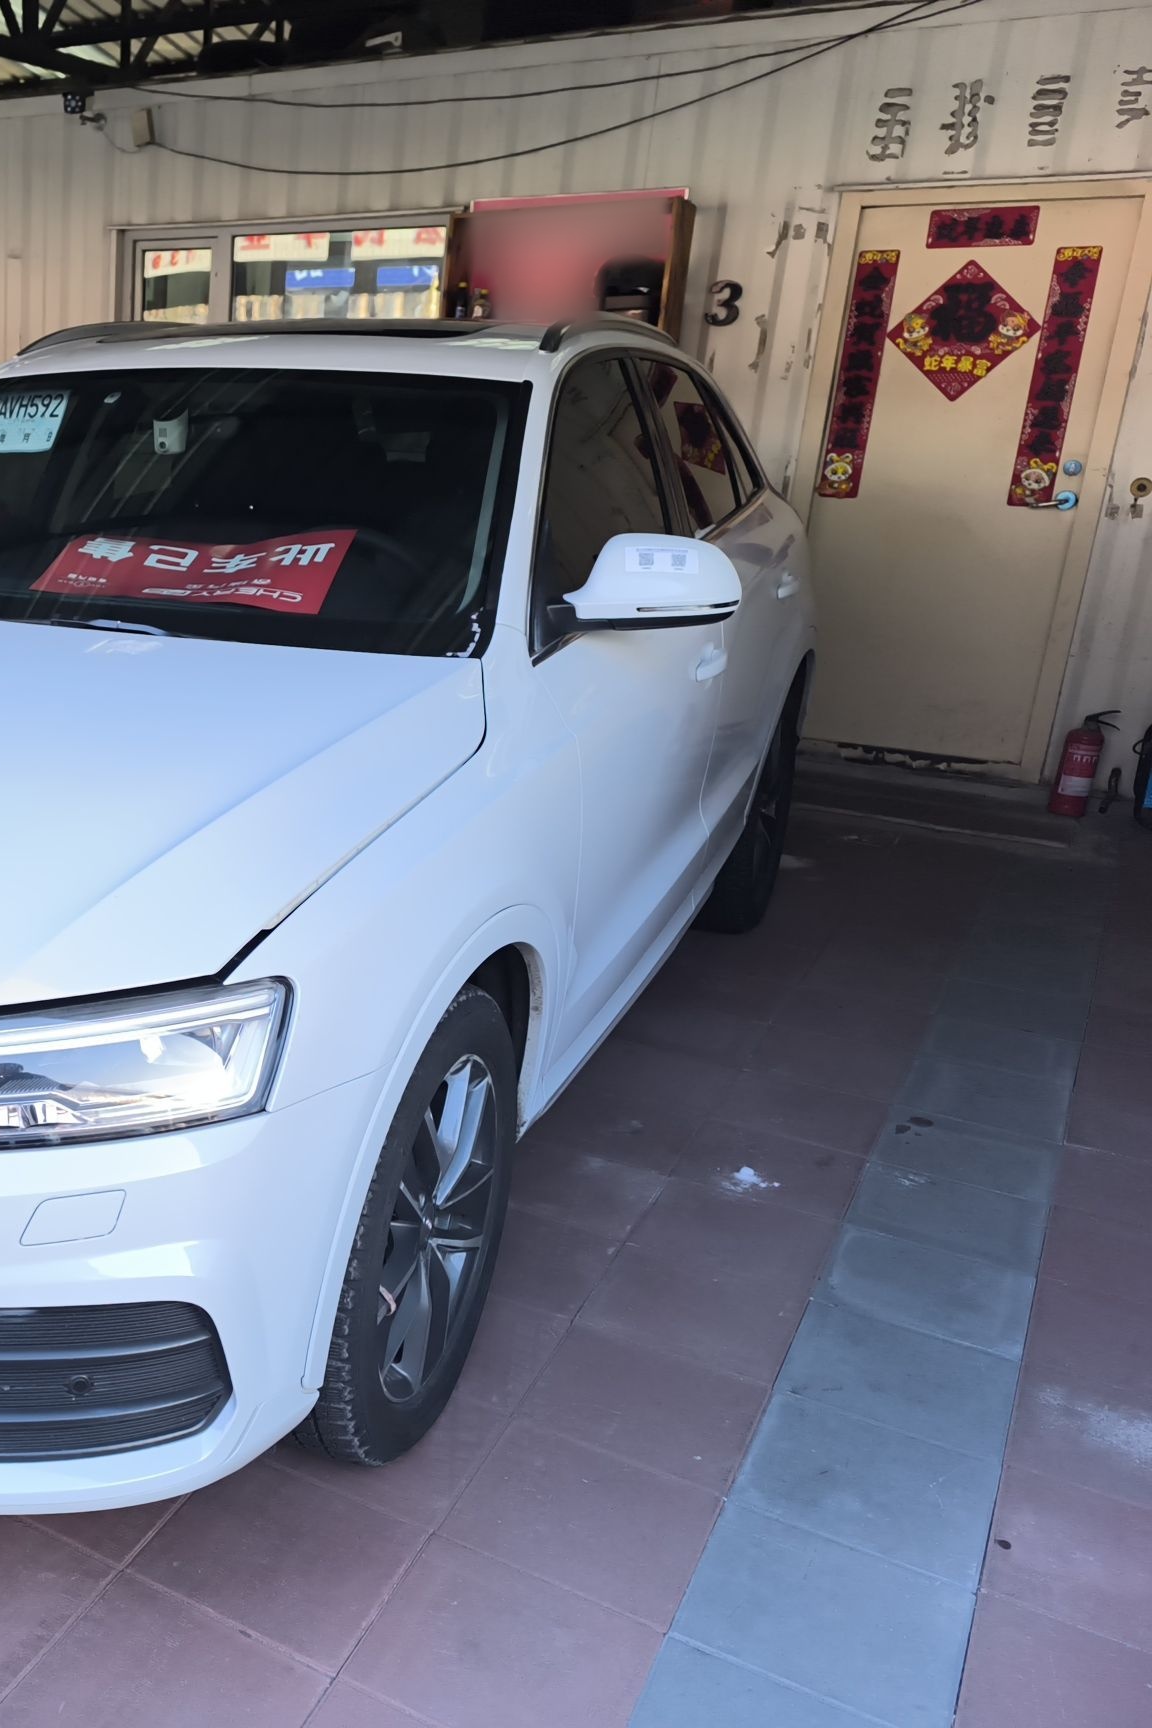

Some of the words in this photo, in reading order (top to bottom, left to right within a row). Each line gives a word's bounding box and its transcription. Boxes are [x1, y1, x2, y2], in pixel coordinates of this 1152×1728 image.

[704, 280, 743, 327] 3
[78, 537, 336, 574] 此车已售
